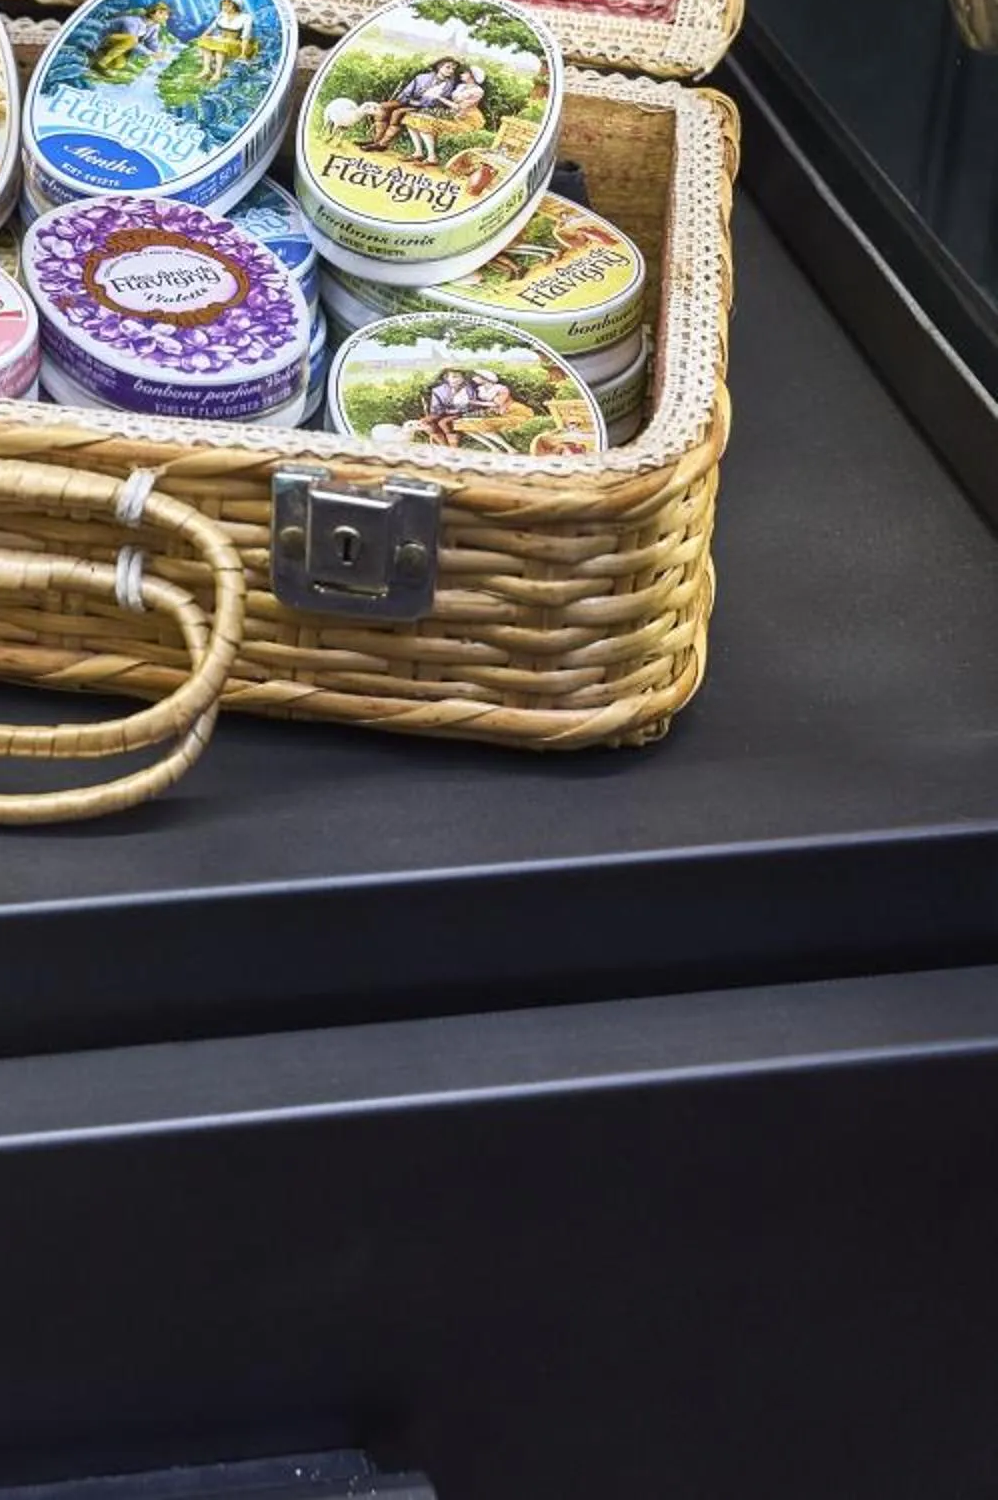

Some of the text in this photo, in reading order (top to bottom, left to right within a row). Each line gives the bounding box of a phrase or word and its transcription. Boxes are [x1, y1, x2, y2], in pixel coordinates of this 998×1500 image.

[48, 86, 197, 163] Flavigny
[64, 145, 139, 176] Menthe
[355, 158, 461, 195] les Anis de
[320, 153, 458, 213] Flavigny
[317, 204, 389, 245] bonbons
[392, 234, 437, 247] anis
[109, 268, 222, 293] Flavigny
[516, 250, 631, 308] Flavigny
[132, 379, 203, 400] bonbons
